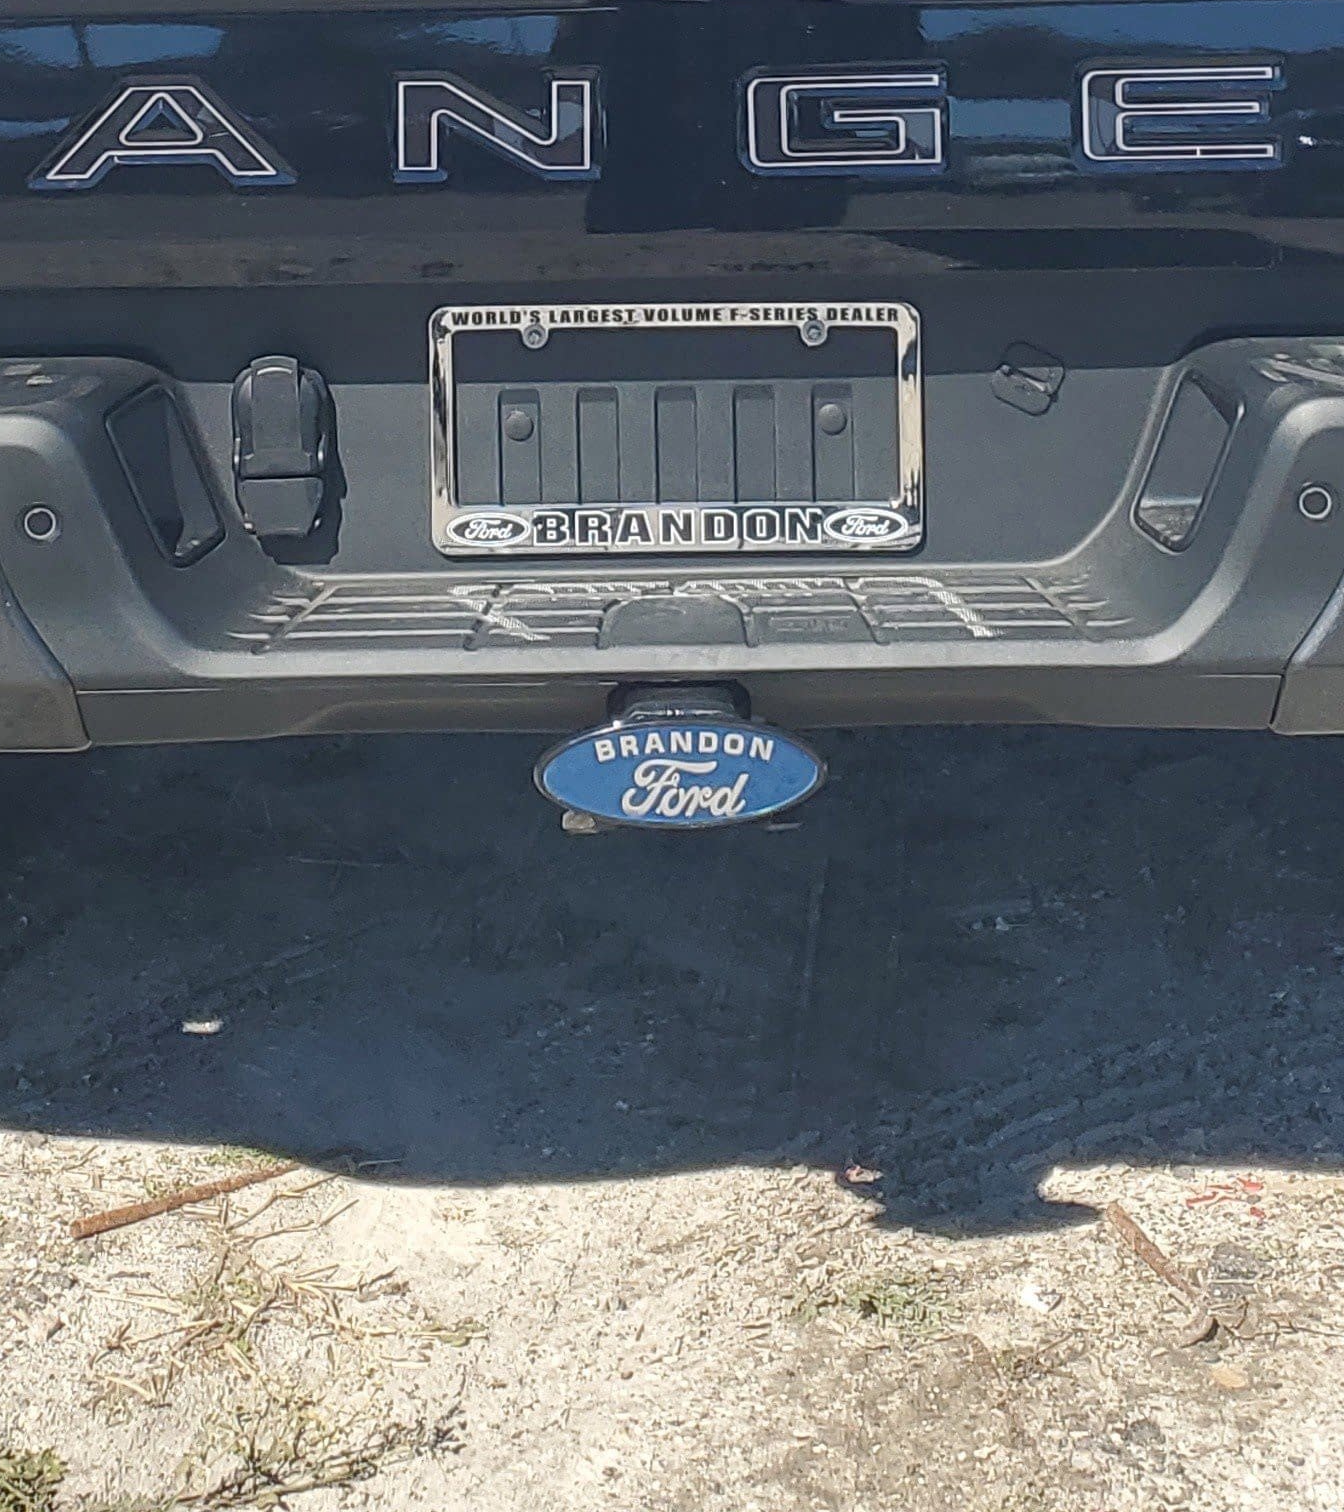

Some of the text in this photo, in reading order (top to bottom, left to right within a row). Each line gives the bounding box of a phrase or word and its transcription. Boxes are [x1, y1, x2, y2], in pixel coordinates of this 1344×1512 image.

[451, 306, 899, 326] WORLD'S LARGEST VOLUME F-SERIES DEALER
[464, 508, 890, 547] Ford BRANDON Ford
[594, 731, 774, 763] BRANDON
[621, 758, 750, 818] Ford
